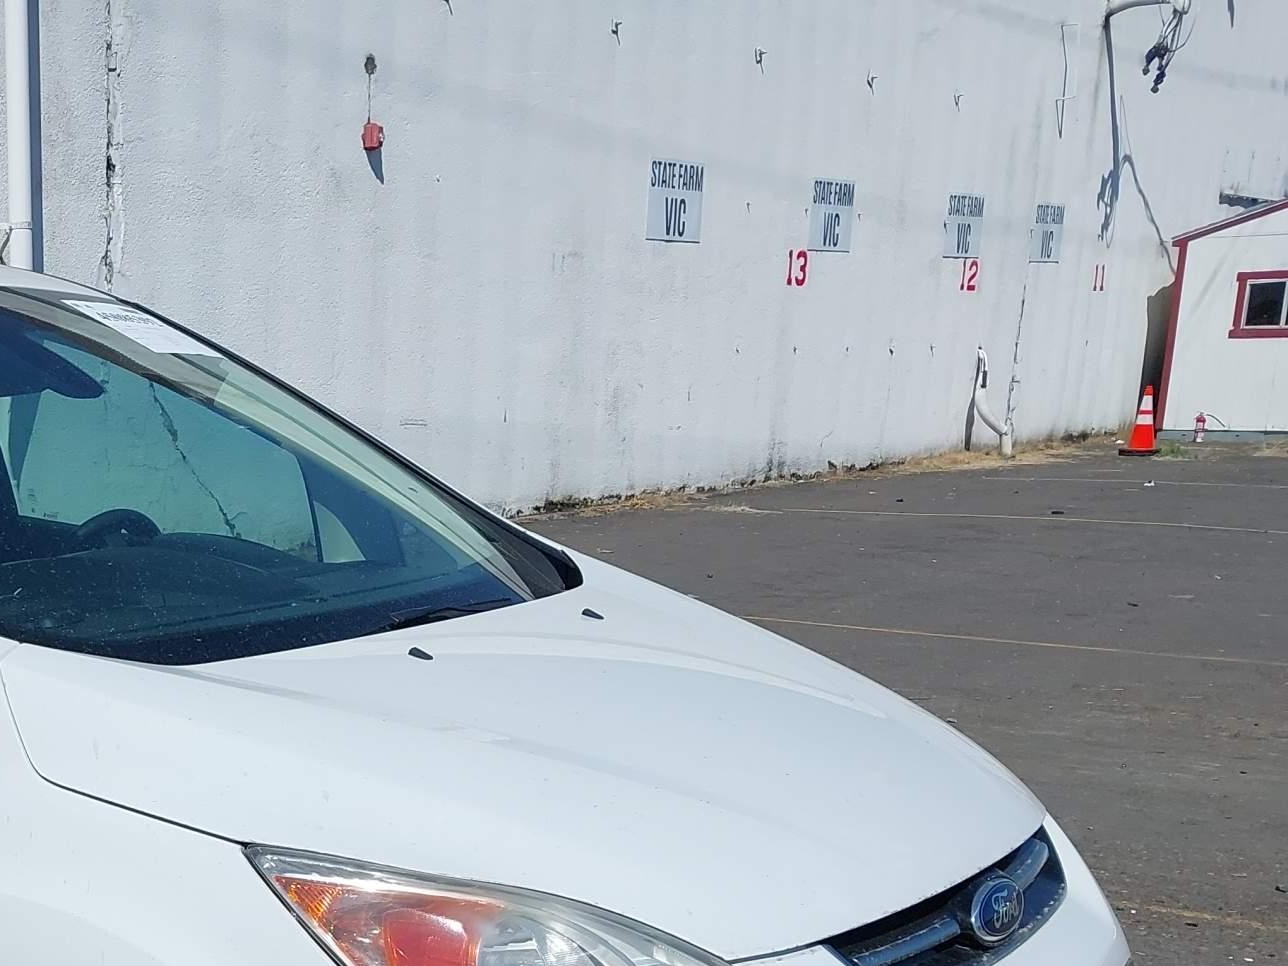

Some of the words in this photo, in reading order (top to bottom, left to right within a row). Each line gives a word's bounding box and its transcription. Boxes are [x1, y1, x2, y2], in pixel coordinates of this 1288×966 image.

[651, 160, 677, 189] STATE
[678, 163, 704, 192] FARM
[813, 180, 833, 205] STATE
[833, 182, 855, 207] FARM
[948, 194, 967, 217] STATE
[966, 196, 984, 218] FARM
[665, 196, 686, 237] VIC
[822, 211, 840, 247] VIC
[1035, 205, 1050, 224] STATE
[957, 223, 971, 254] VIC
[1040, 230, 1054, 259] VIC
[787, 249, 808, 286] 13
[960, 258, 979, 291] 12
[1093, 264, 1105, 292] 11
[992, 889, 1019, 928] Ford
